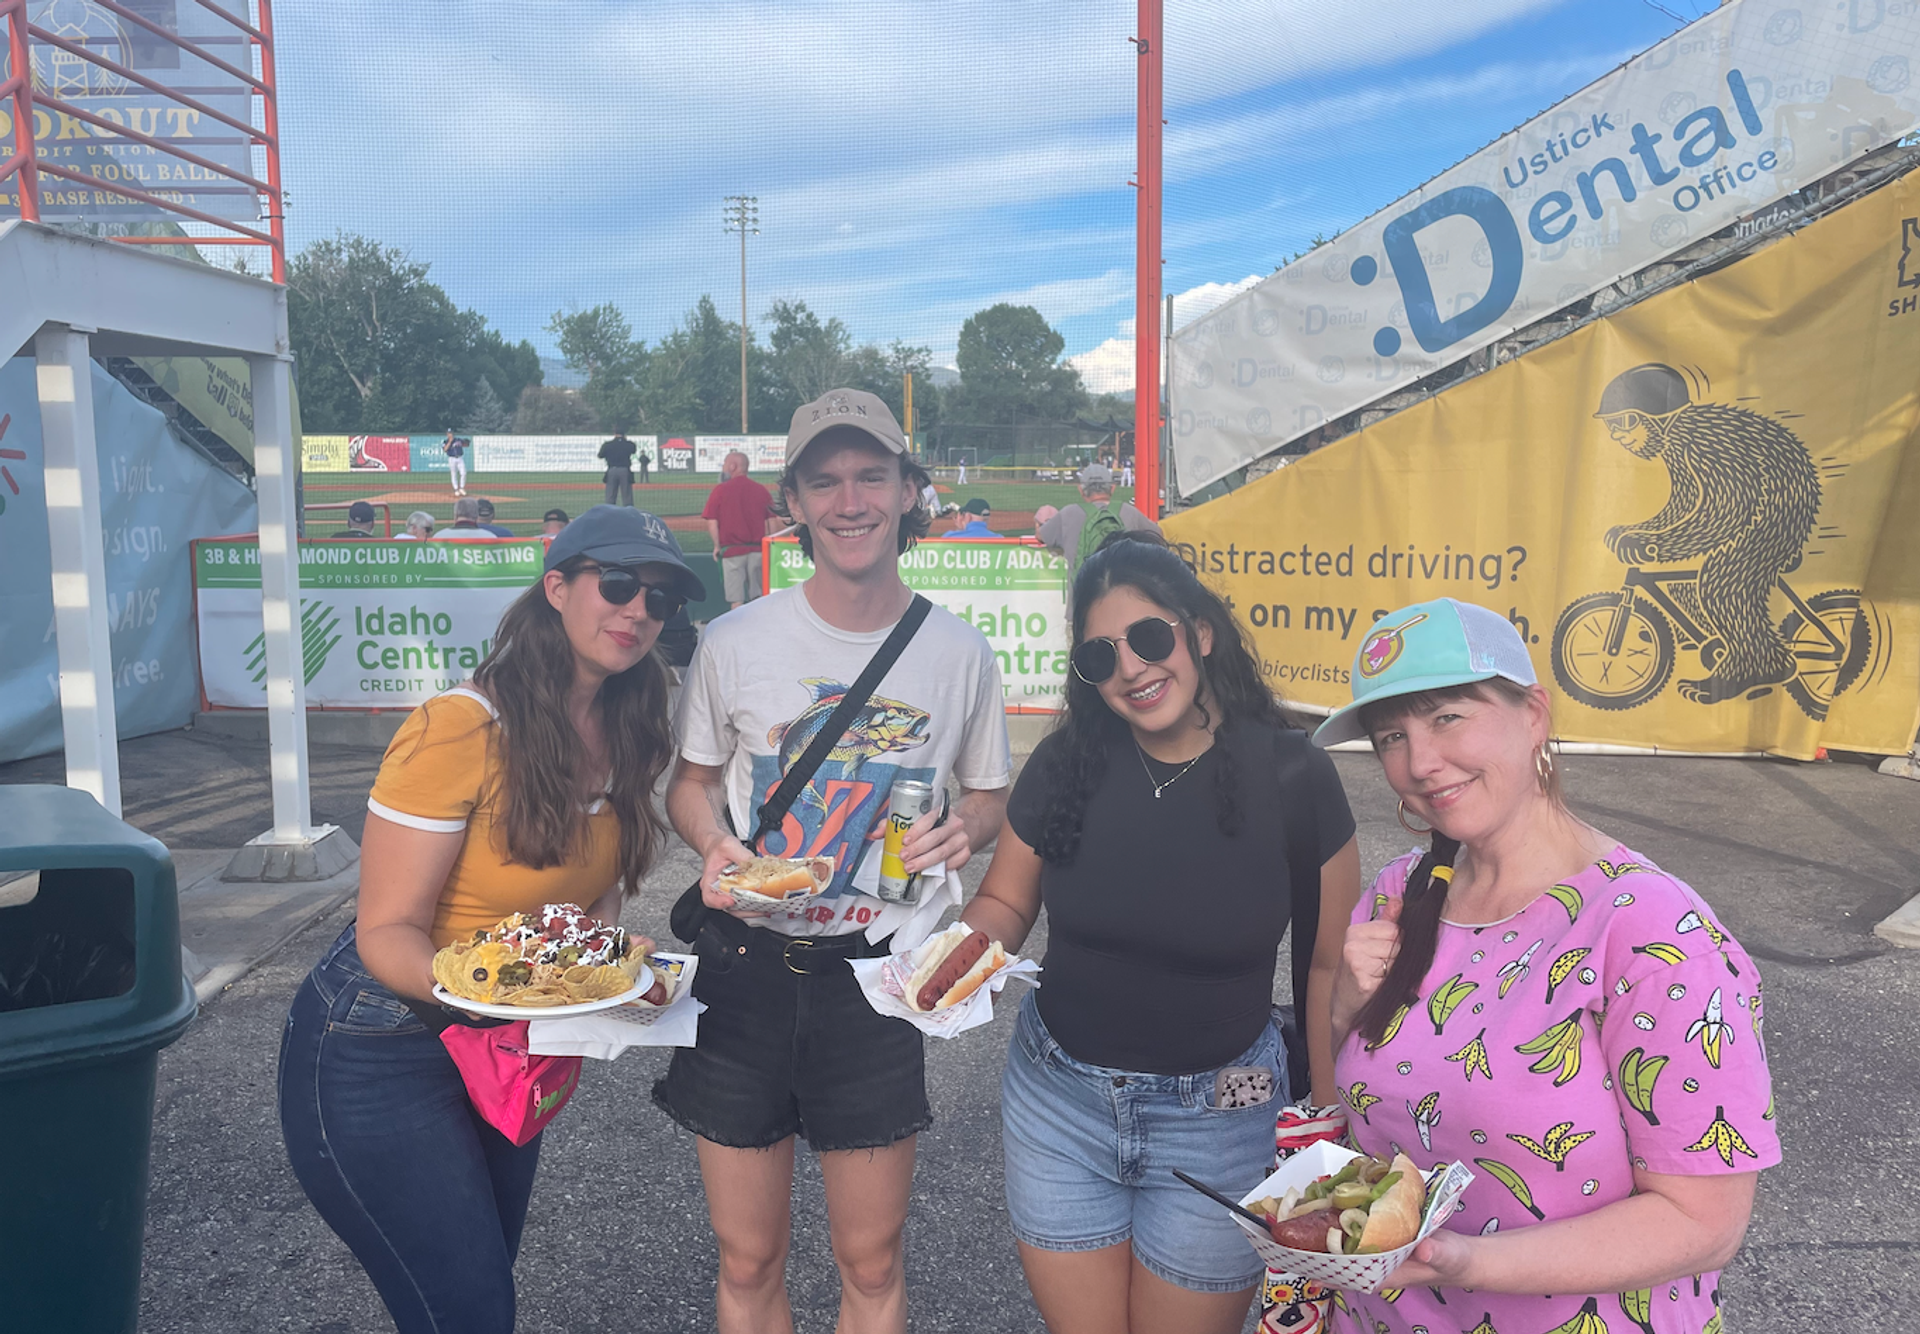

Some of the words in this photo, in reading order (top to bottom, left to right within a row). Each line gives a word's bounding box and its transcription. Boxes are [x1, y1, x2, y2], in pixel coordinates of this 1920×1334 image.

[2, 146, 73, 157] RDIT
[86, 144, 157, 157] UNION
[1503, 112, 1615, 189] Ustick
[90, 164, 151, 181] FOUL
[1673, 150, 1779, 212] Office
[43, 191, 89, 205] BASE
[812, 405, 868, 422] ZION
[662, 447, 692, 460] Pizza
[640, 512, 669, 545] LA
[204, 548, 224, 564] 3B
[228, 548, 241, 564] &
[354, 547, 400, 564] CLUB
[404, 548, 410, 564] /
[414, 548, 449, 564] ADA
[463, 546, 535, 565] SEATING
[781, 550, 803, 569] 3B
[943, 550, 991, 569] CLUB
[995, 550, 1002, 569] /
[1006, 550, 1044, 569] ADA
[1177, 542, 1354, 578] Distracted
[1367, 545, 1528, 590] driving?
[318, 574, 400, 584] SPONSORED
[406, 574, 422, 584] BY
[903, 576, 986, 585] SPONSORED
[995, 576, 1012, 585] BY
[354, 605, 452, 637] Idaho
[1250, 603, 1291, 628] on
[1304, 605, 1358, 641] my
[1262, 659, 1351, 684] bicyclists
[360, 679, 424, 692] CREDIT
